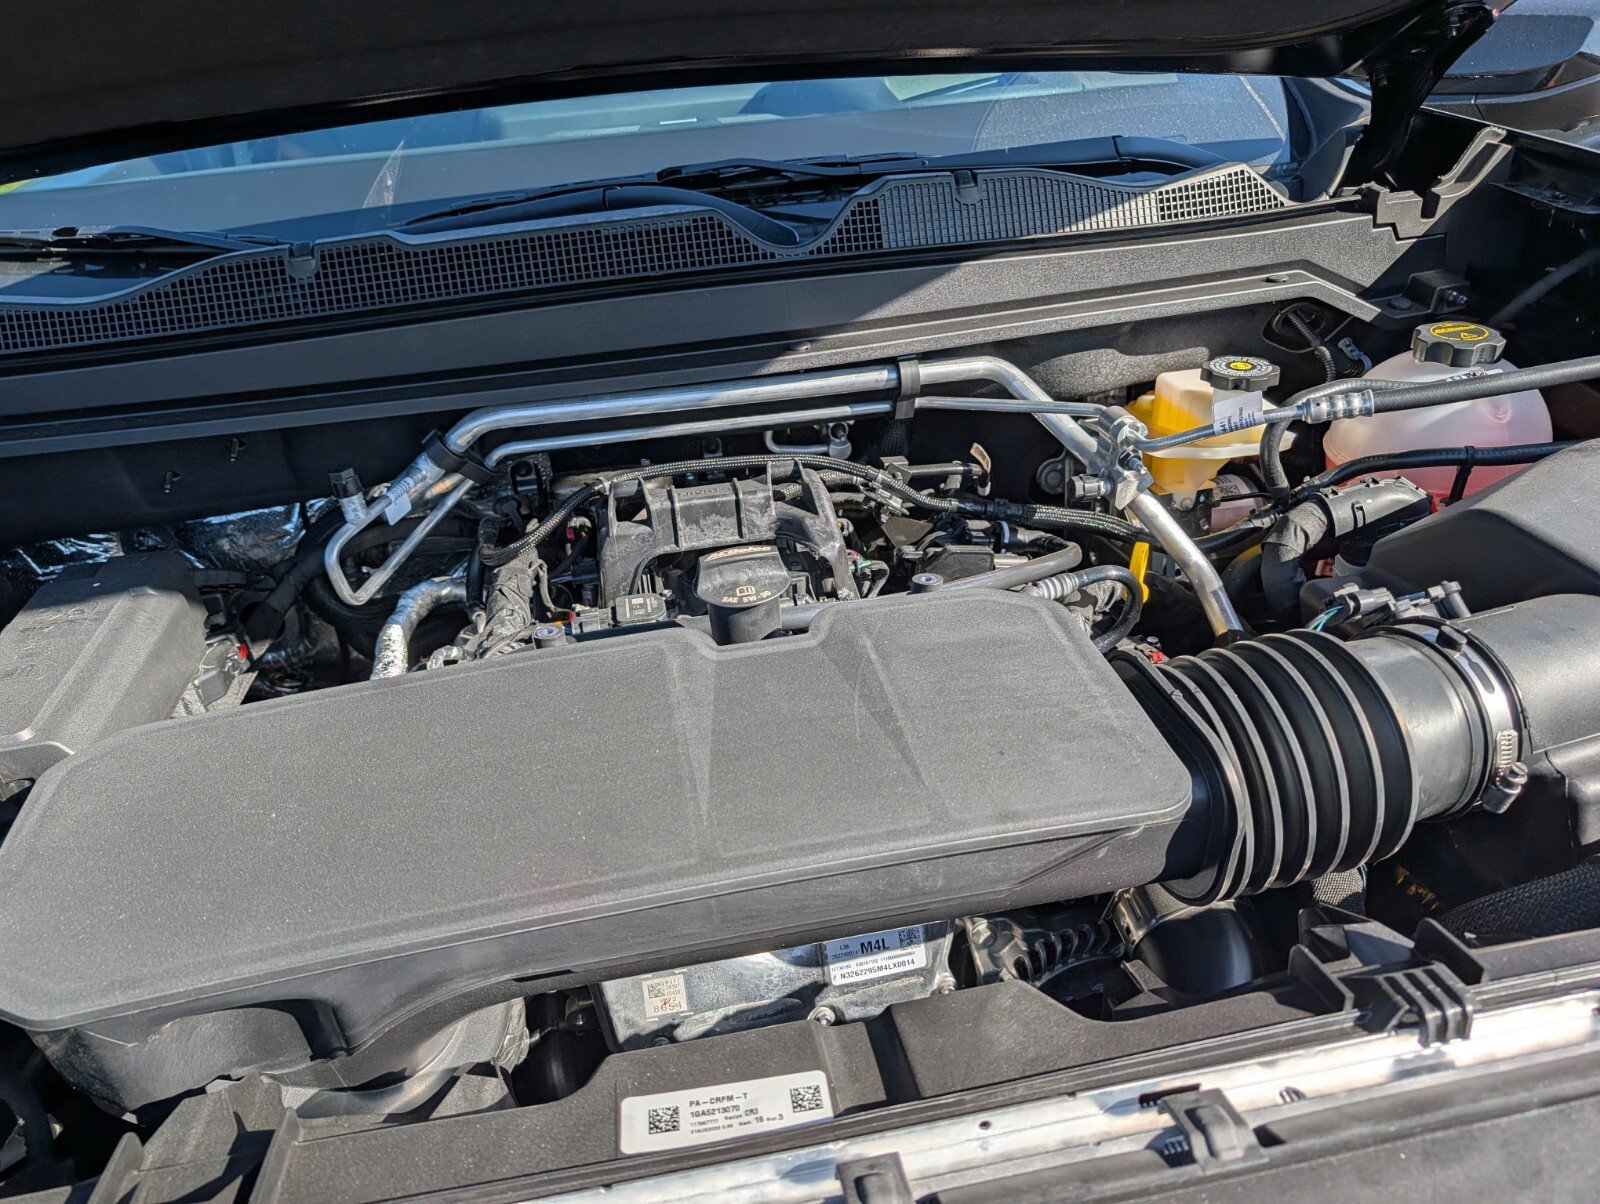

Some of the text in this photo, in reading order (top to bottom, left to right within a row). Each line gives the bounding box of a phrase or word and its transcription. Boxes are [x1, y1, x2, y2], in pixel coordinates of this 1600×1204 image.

[722, 596, 739, 604] SAE
[860, 938, 889, 954] M4L
[744, 1107, 759, 1117] CR3
[755, 1115, 764, 1124] 16
[778, 1113, 784, 1121] 3
